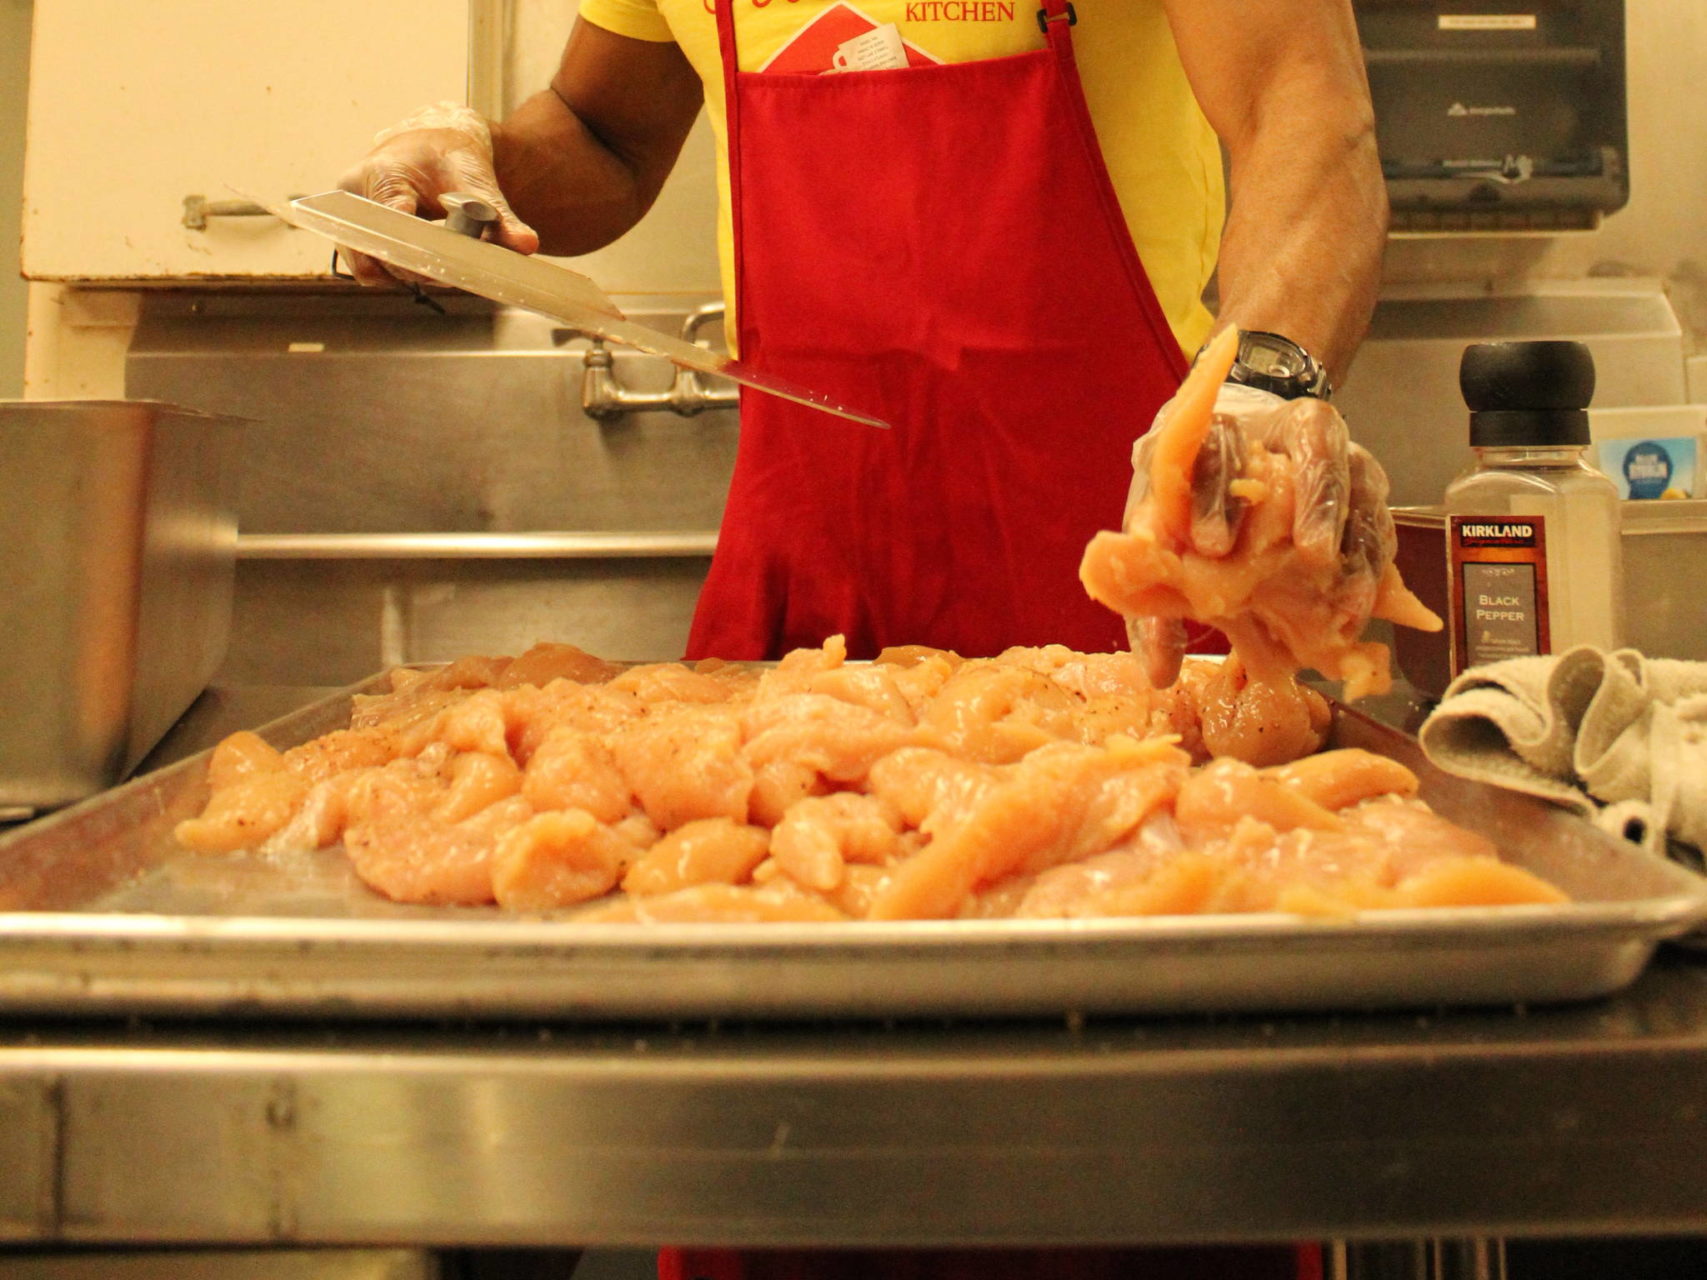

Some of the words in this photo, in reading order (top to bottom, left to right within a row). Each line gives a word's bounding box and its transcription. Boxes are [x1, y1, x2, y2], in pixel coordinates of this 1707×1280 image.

[905, 1, 1016, 22] KITCHEN
[1462, 524, 1533, 538] KIRKLAND
[1479, 594, 1520, 607] BLACK
[1476, 609, 1525, 622] PEPPER
